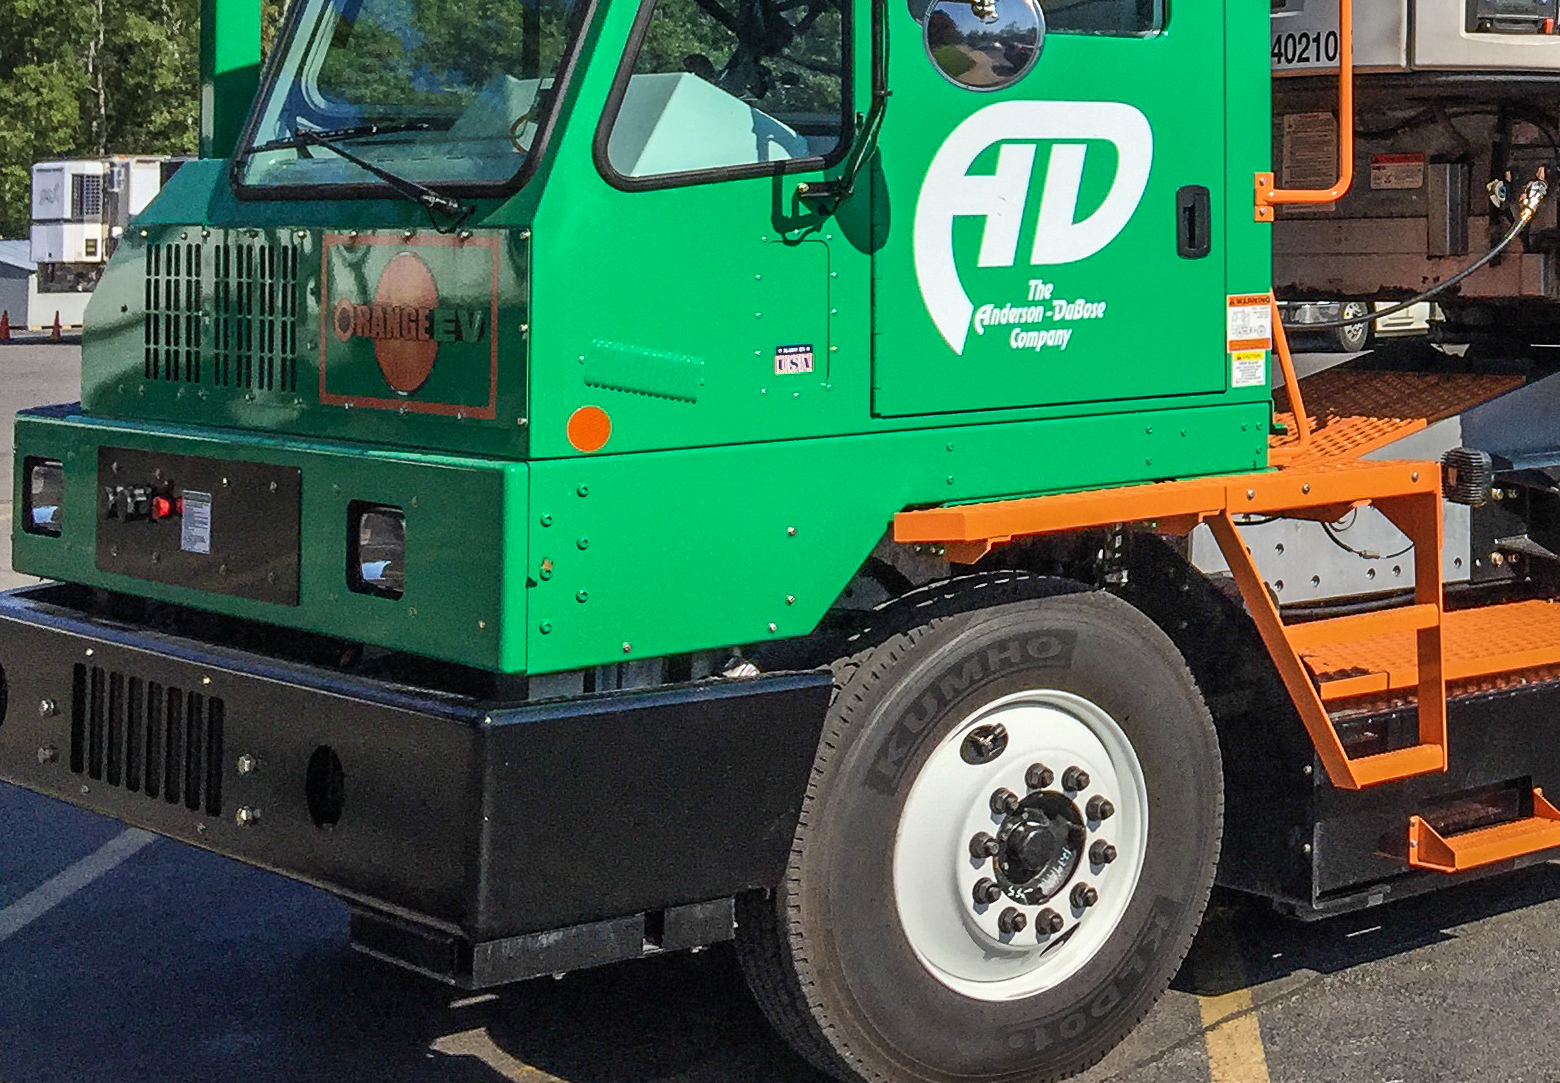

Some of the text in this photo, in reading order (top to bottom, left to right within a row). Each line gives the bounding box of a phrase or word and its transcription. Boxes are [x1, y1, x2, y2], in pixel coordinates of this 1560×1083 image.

[1270, 30, 1353, 64] 40210
[1027, 279, 1054, 301] The
[1236, 296, 1271, 306] WARNING
[1010, 327, 1073, 352] Company
[875, 634, 1064, 778] KUMHO
